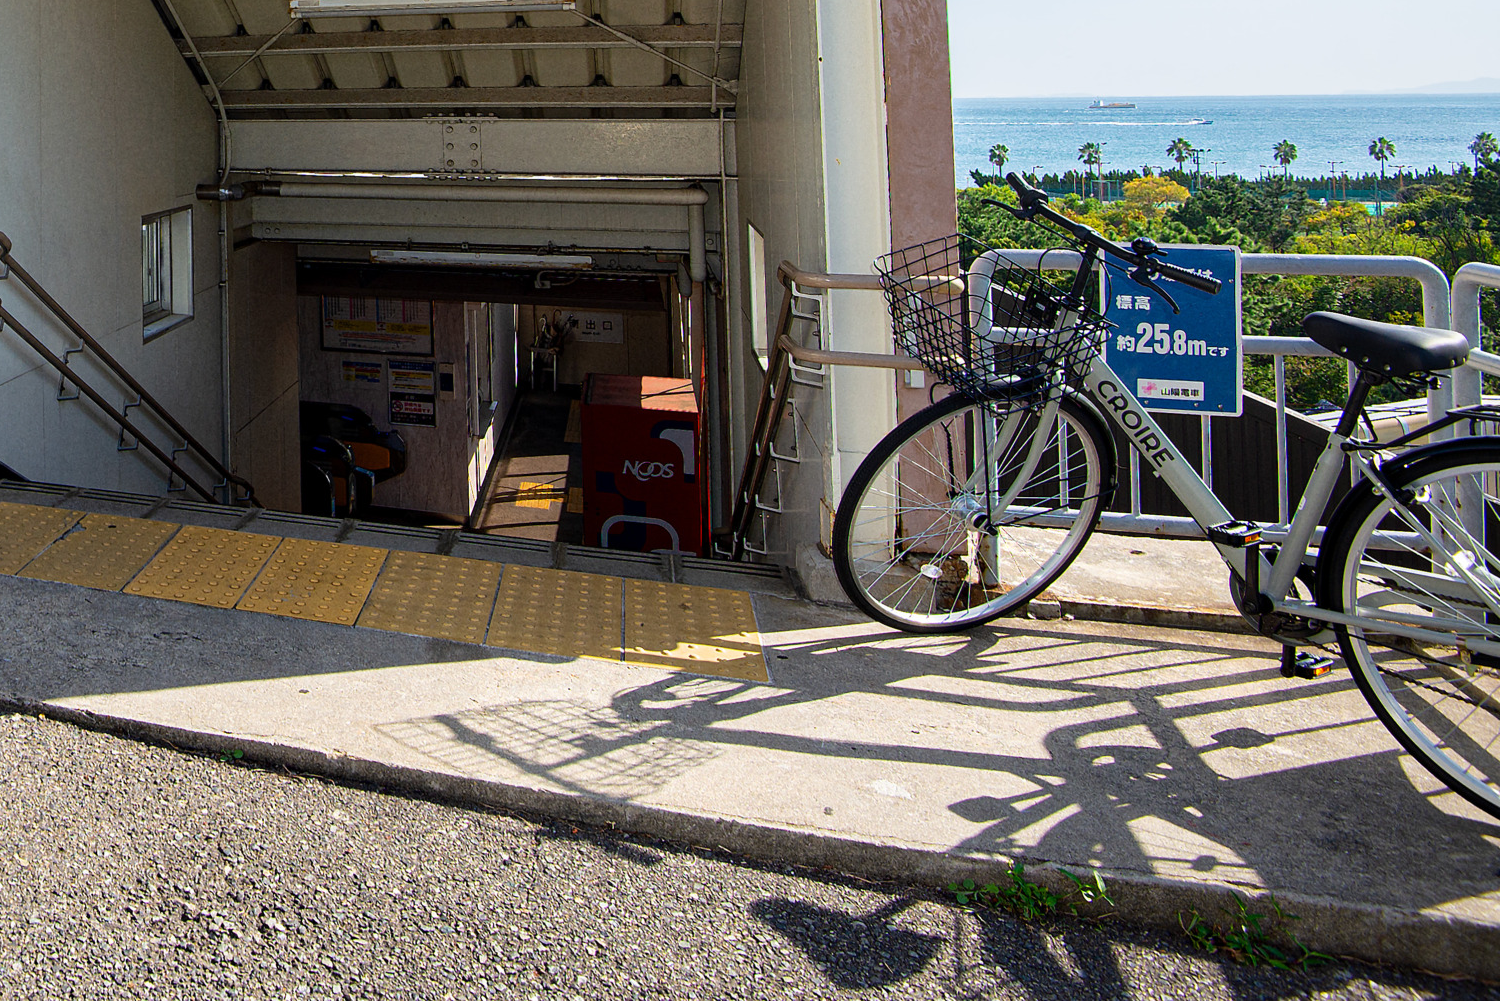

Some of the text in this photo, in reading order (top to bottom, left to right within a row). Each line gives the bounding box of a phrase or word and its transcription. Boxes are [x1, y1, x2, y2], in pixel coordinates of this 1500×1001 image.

[1115, 295, 1151, 311] 標高
[1116, 322, 1230, 357] 約25.8mです
[1098, 380, 1175, 468] CROIRE
